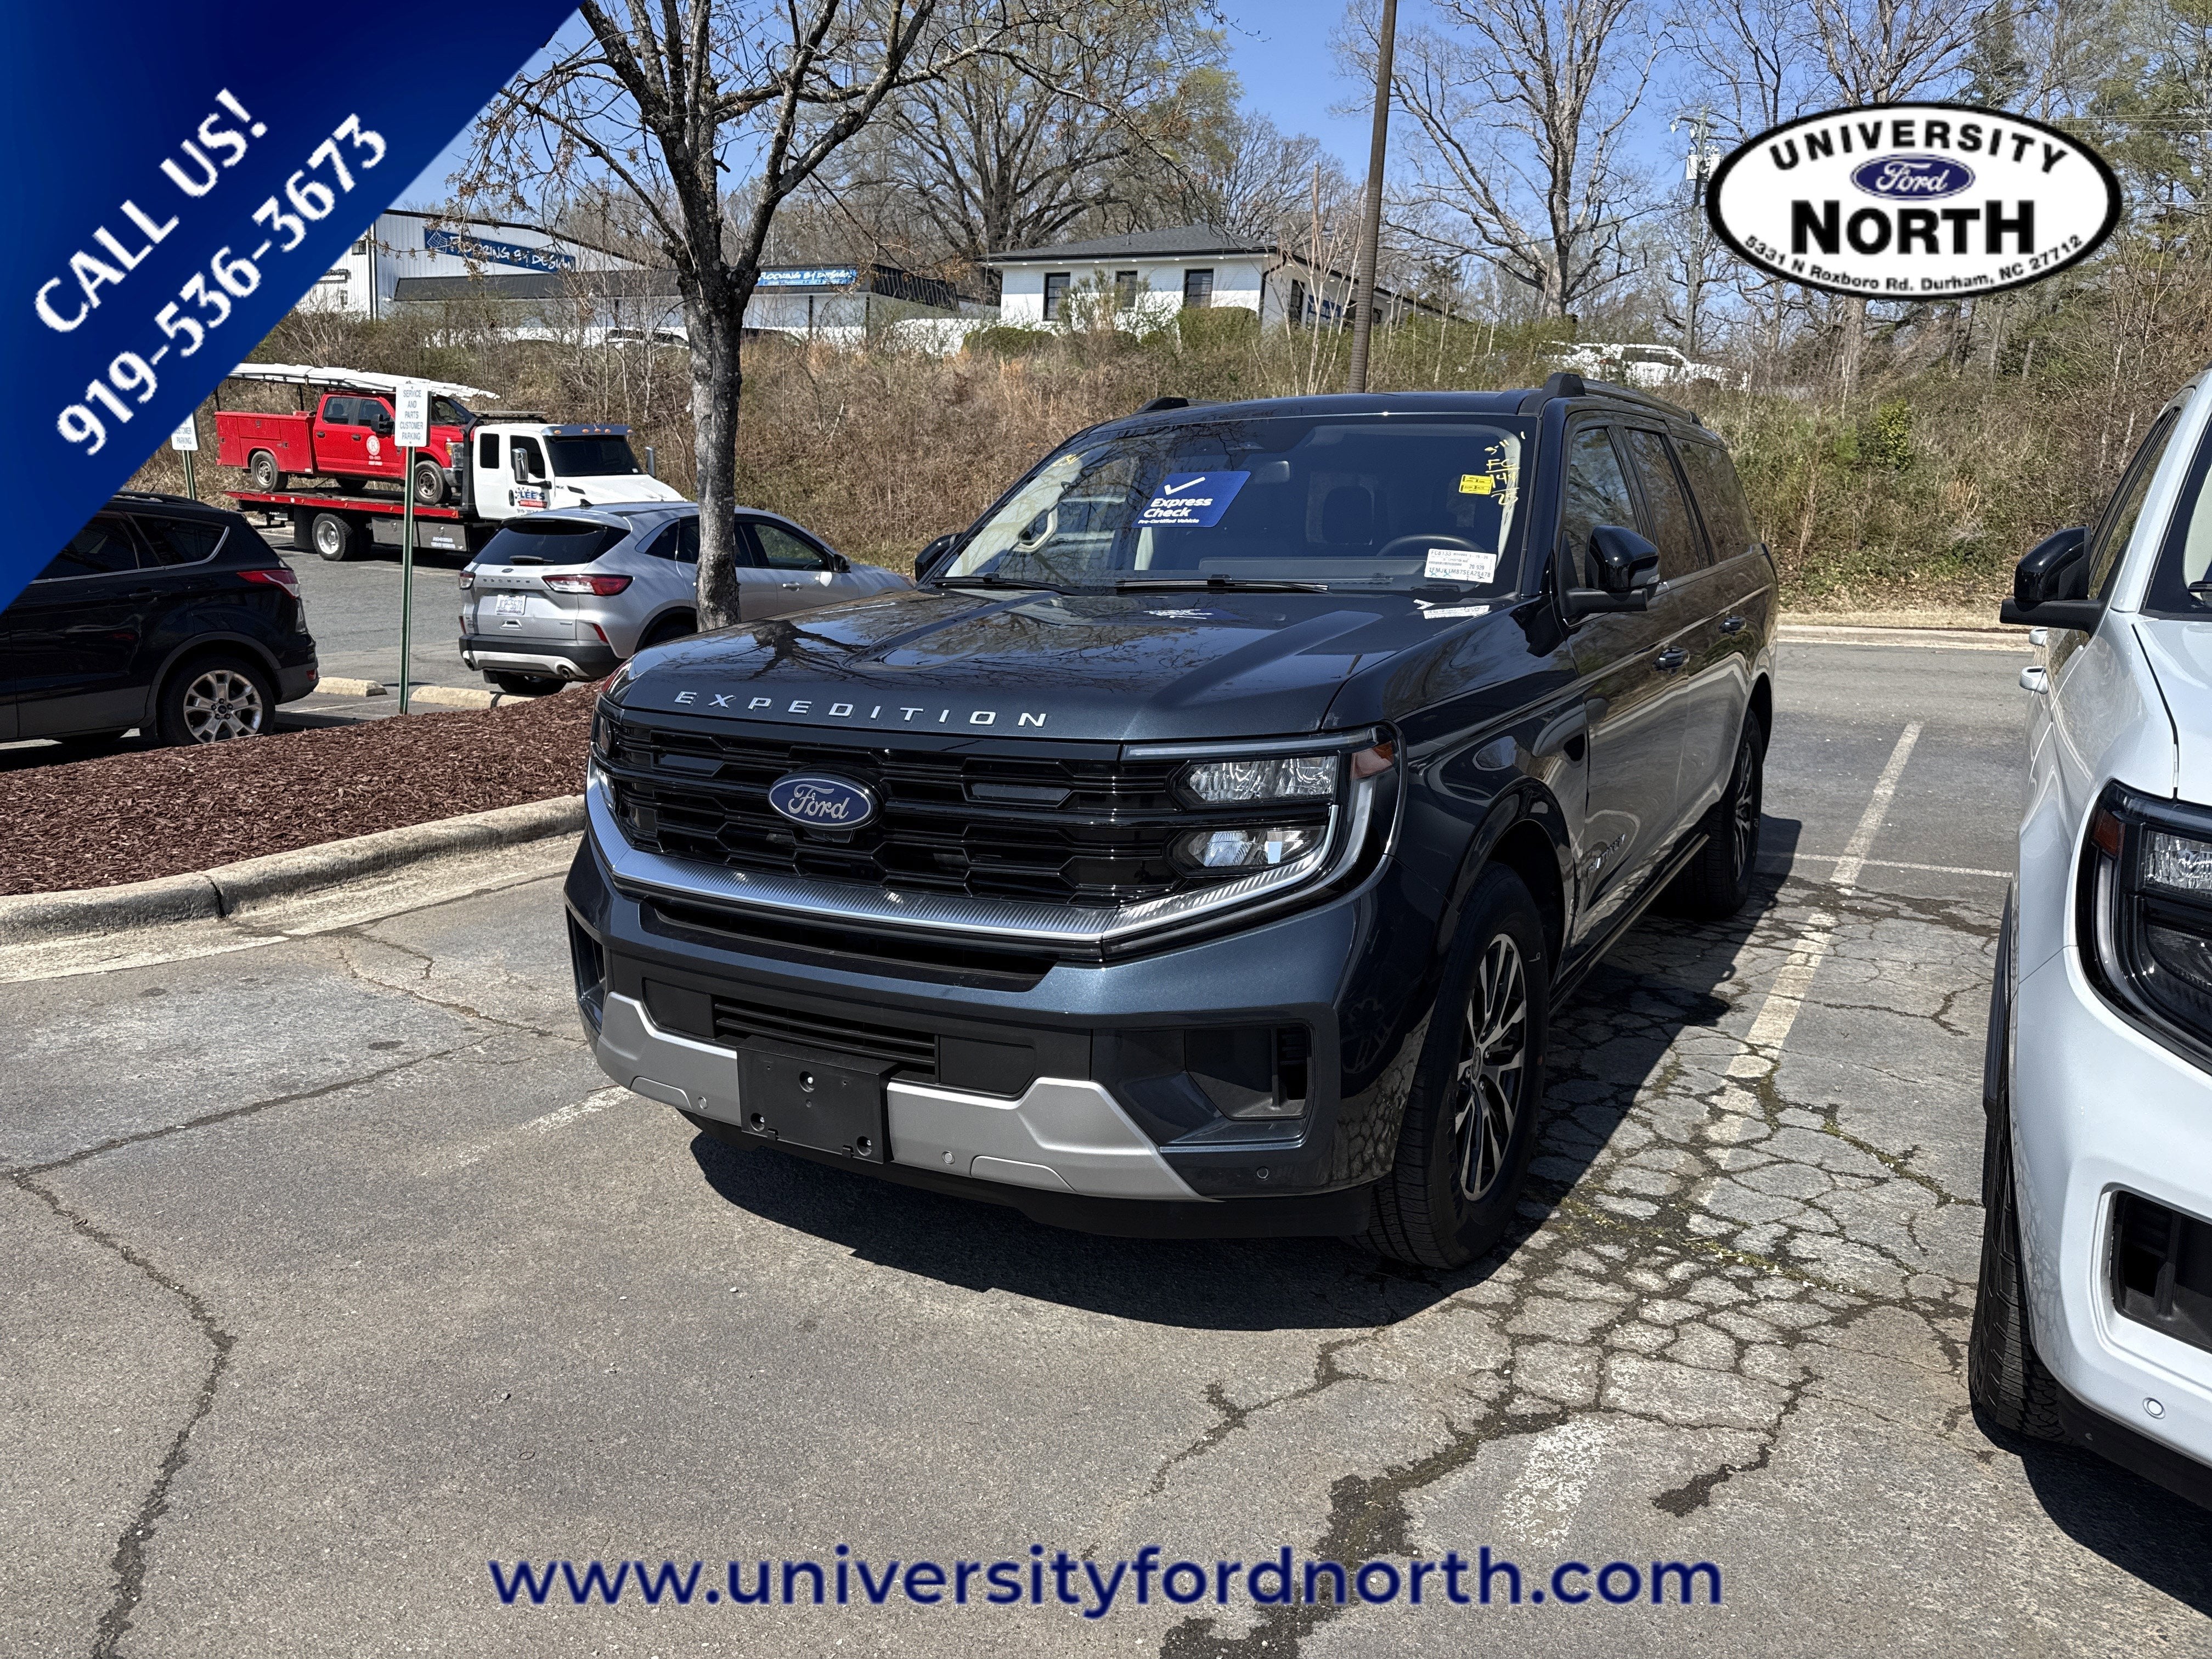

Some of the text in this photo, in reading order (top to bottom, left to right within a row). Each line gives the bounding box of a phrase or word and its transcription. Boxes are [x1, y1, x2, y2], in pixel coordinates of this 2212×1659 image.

[449, 236, 510, 260] FOORING
[403, 390, 422, 398] SERVICE
[400, 421, 424, 430] CUSTOMER
[402, 432, 421, 440] PARKING
[1150, 498, 1214, 508] Express
[1143, 507, 1193, 517] Check
[674, 691, 1047, 727] EXPEDITION
[788, 783, 850, 820] Ford
